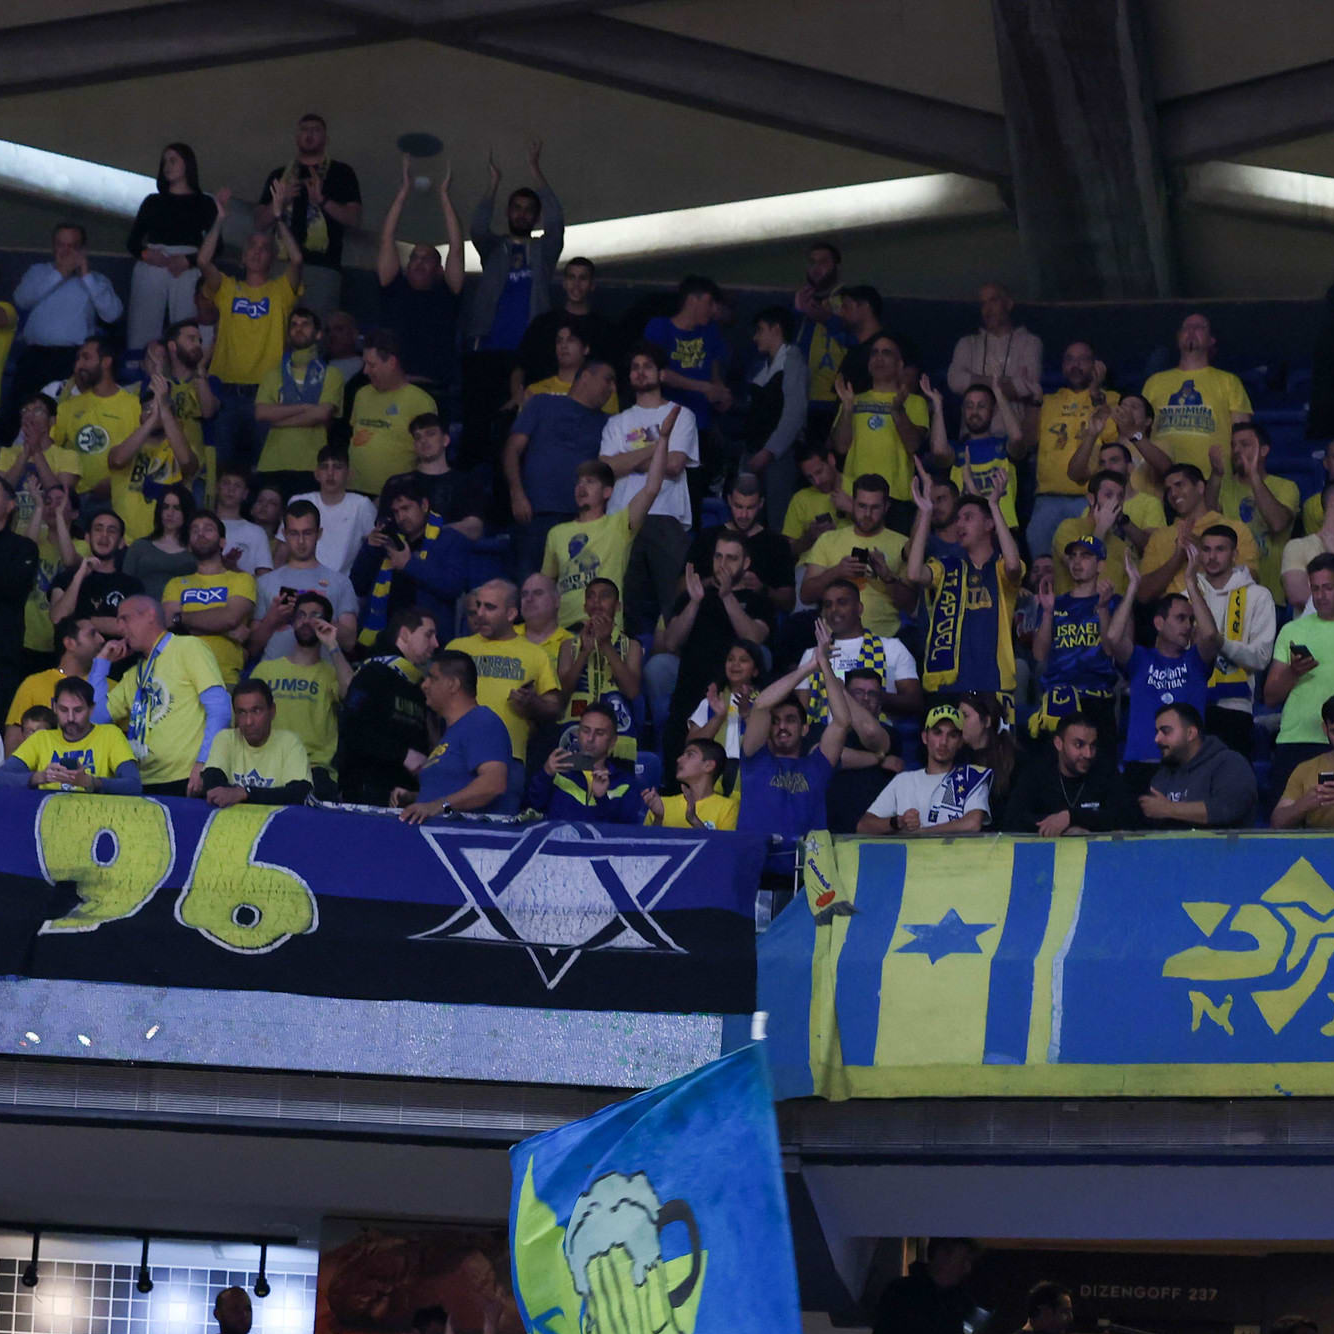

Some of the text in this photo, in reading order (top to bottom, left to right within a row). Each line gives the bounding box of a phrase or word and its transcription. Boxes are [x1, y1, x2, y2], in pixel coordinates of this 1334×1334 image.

[182, 588, 223, 602] FOX
[35, 795, 319, 955] 96
[1079, 1284, 1218, 1302] DIZENGOFF 237
